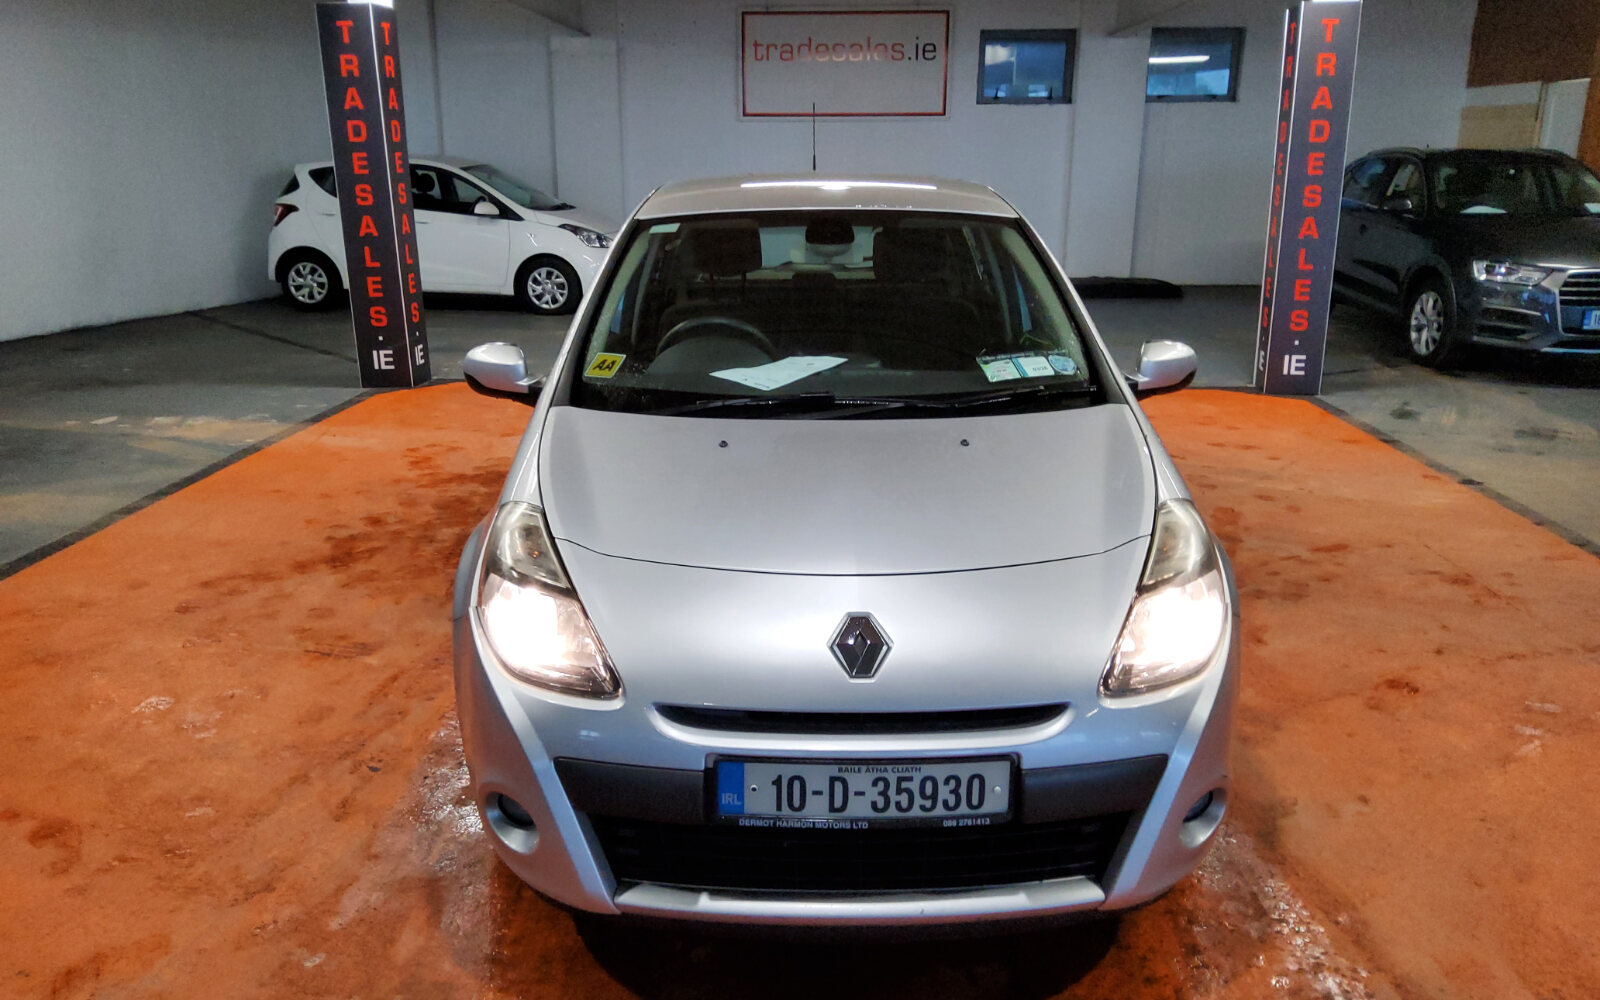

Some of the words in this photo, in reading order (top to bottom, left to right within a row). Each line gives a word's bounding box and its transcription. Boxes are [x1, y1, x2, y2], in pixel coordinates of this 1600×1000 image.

[593, 359, 618, 371] AA
[837, 766, 861, 774] BAILE
[891, 765, 922, 774] CLIATH
[721, 792, 742, 805] IRL
[771, 773, 986, 813] 10-D-35930
[739, 818, 774, 828] DERMOT
[852, 820, 869, 829] LTD
